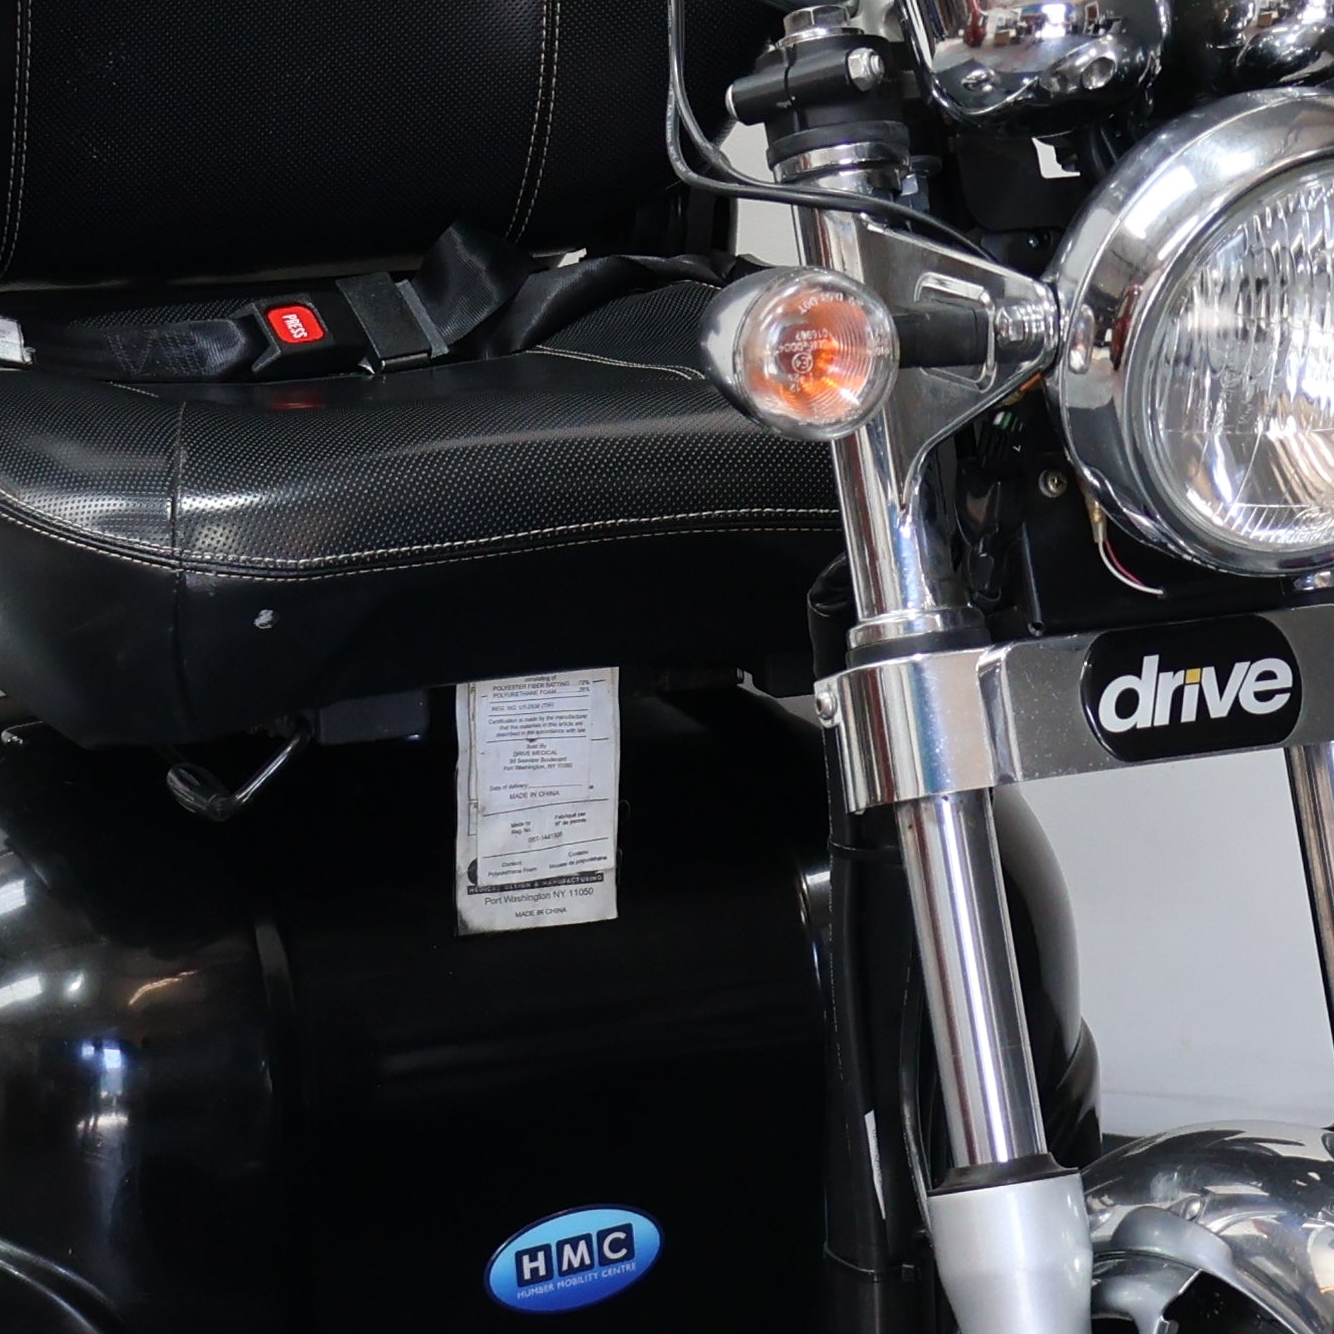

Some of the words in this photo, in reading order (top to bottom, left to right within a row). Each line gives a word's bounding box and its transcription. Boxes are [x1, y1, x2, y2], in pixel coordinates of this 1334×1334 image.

[281, 313, 308, 339] PRESS
[1097, 653, 1294, 734] drive
[509, 792, 528, 800] MADE
[538, 789, 560, 798] CHINA
[485, 897, 502, 906] Port
[503, 892, 551, 904] Washington
[553, 890, 566, 898] NY
[569, 886, 594, 897] 11050
[515, 910, 535, 918] MADE
[545, 906, 568, 915] CHINA
[521, 1231, 628, 1281] HMC
[517, 1282, 555, 1300] HUMBER
[557, 1271, 599, 1290] MOBILITY
[601, 1262, 637, 1278] CENTRE
